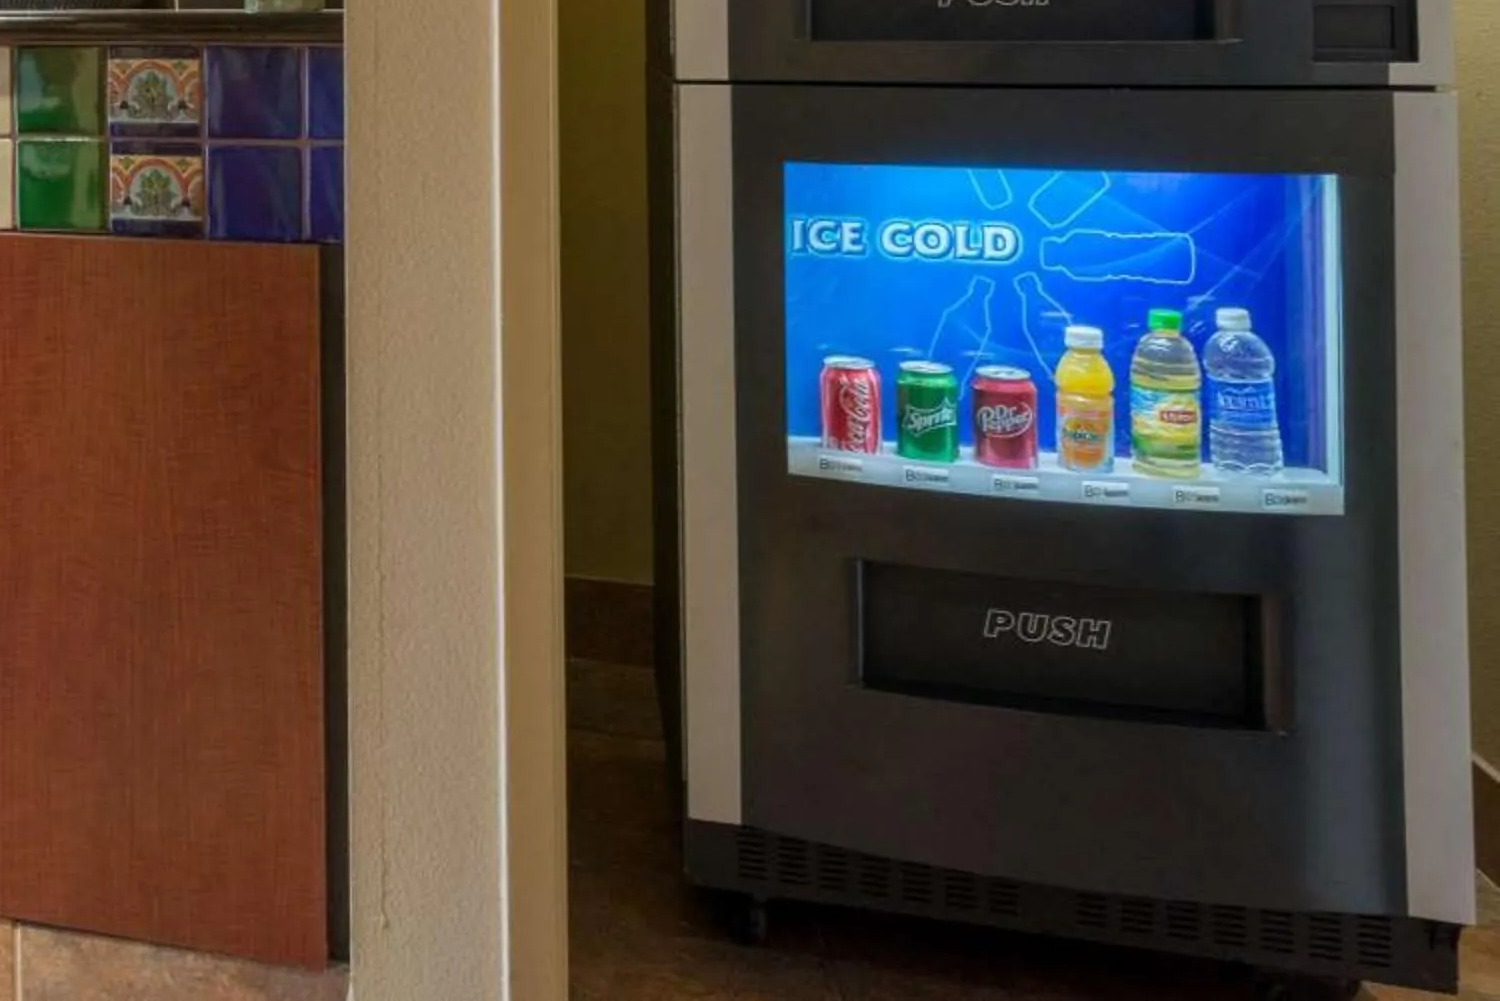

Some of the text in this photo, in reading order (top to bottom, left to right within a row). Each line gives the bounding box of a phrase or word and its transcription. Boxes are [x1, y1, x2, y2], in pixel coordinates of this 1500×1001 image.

[791, 218, 1019, 261] ICE COLD
[994, 404, 1017, 419] Dr
[983, 608, 1112, 650] PUSH
